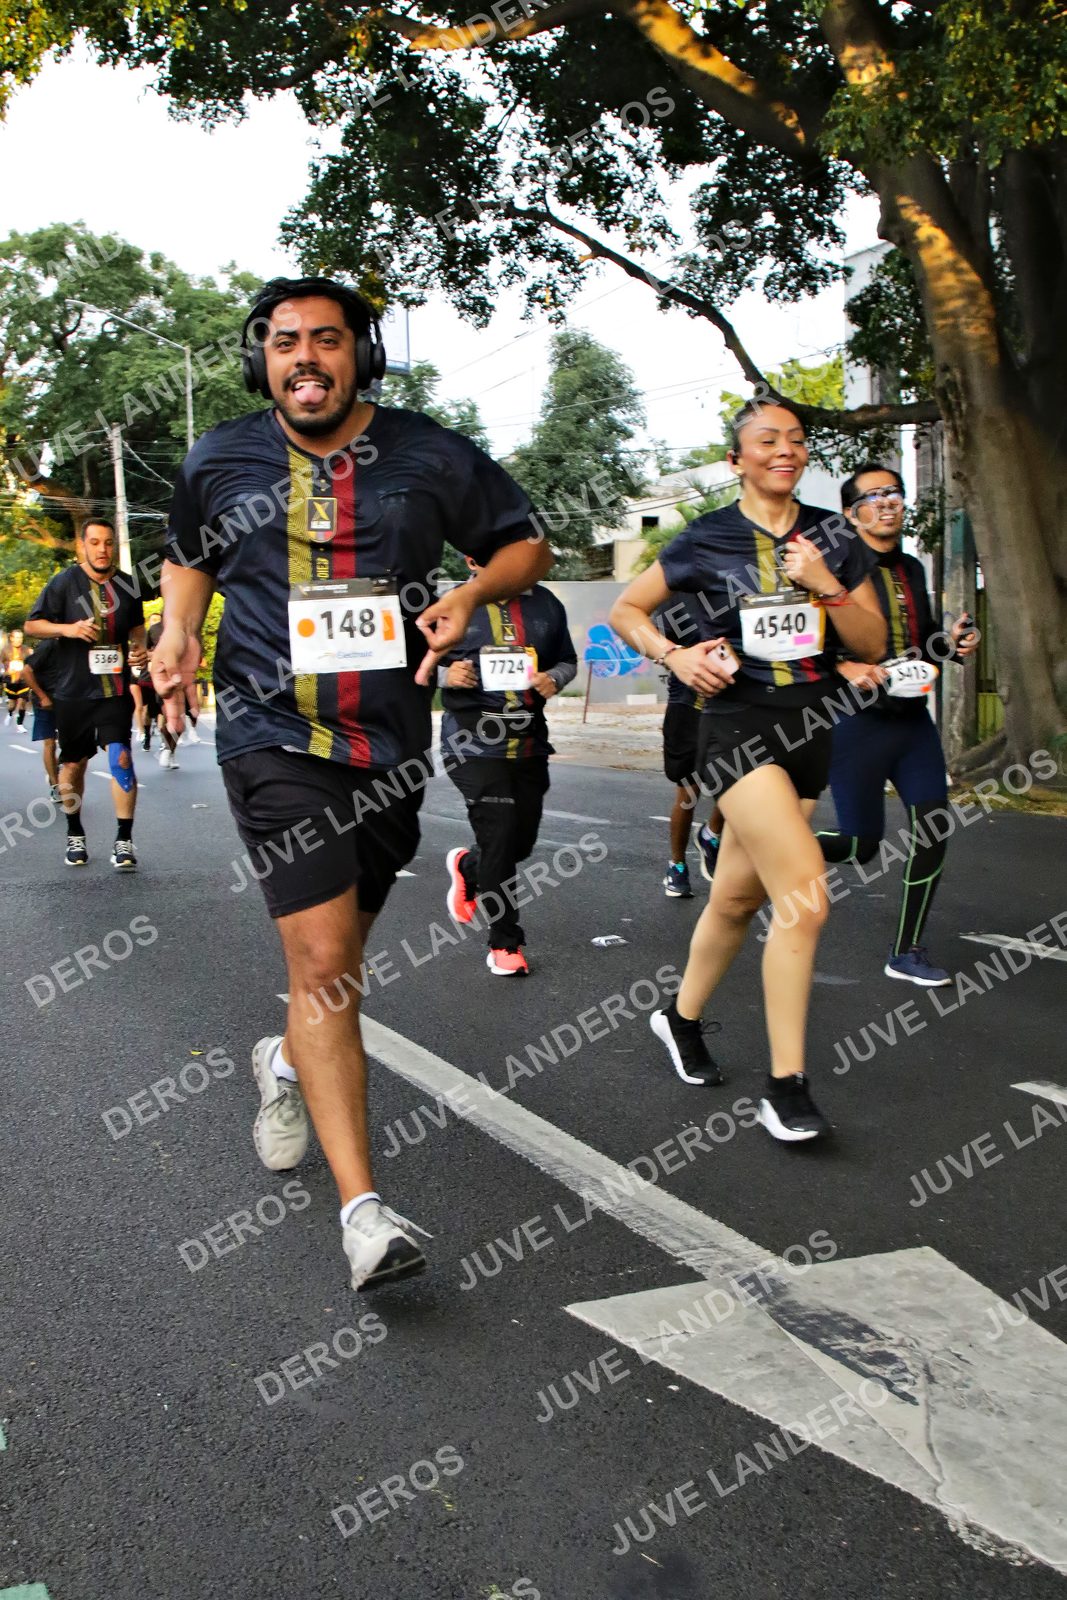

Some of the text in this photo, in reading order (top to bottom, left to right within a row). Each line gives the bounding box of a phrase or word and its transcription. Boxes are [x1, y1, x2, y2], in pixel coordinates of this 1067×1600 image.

[320, 608, 376, 640] 148
[753, 612, 806, 639] 4540
[94, 653, 119, 664] 5369
[489, 659, 525, 674] 7724
